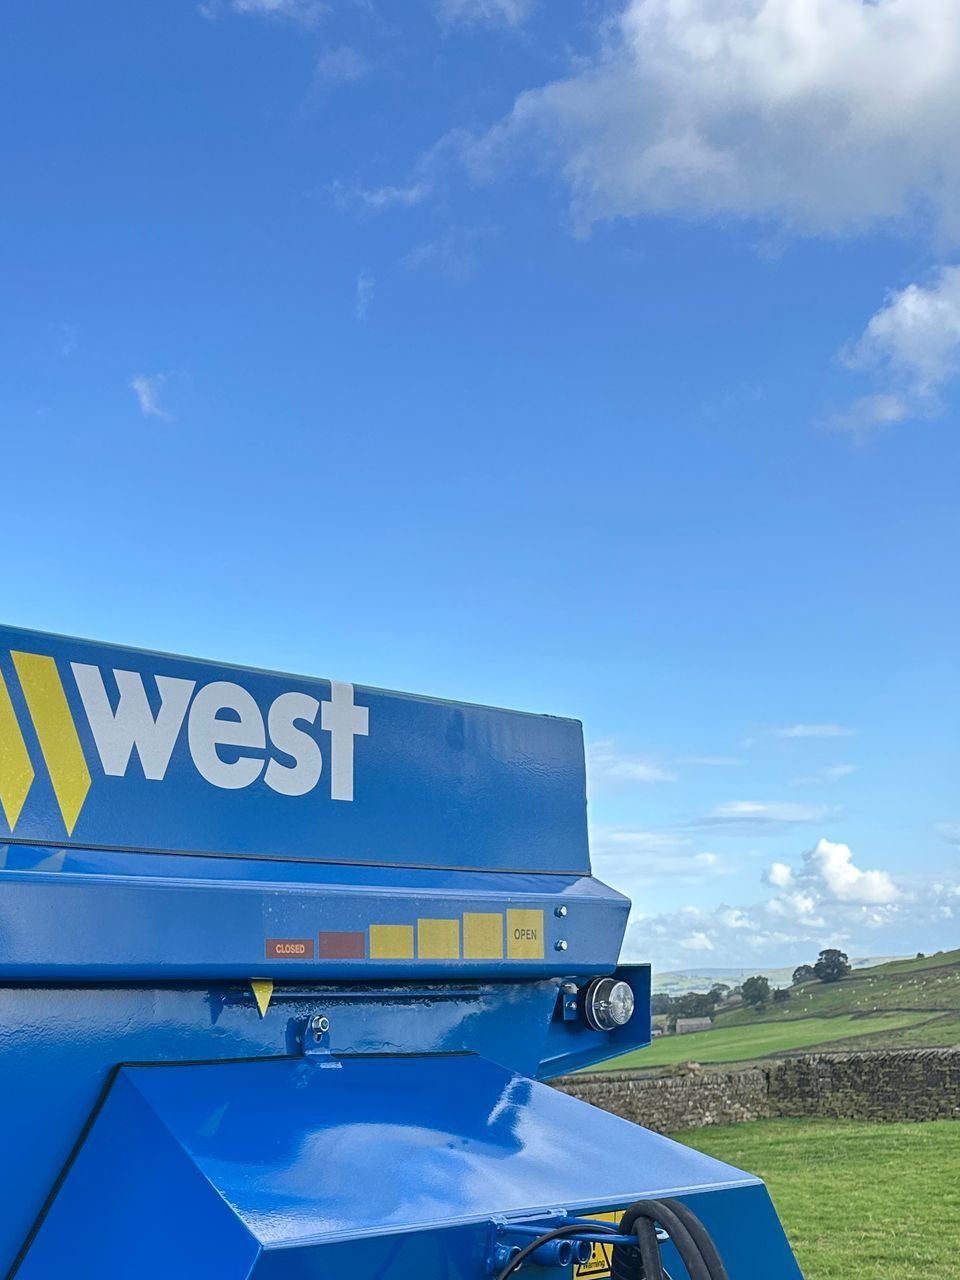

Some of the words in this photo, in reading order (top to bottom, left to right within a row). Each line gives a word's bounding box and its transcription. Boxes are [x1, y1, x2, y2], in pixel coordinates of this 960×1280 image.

[69, 679, 370, 802] west
[513, 928, 537, 940] OPEN
[275, 943, 305, 954] CLOSED
